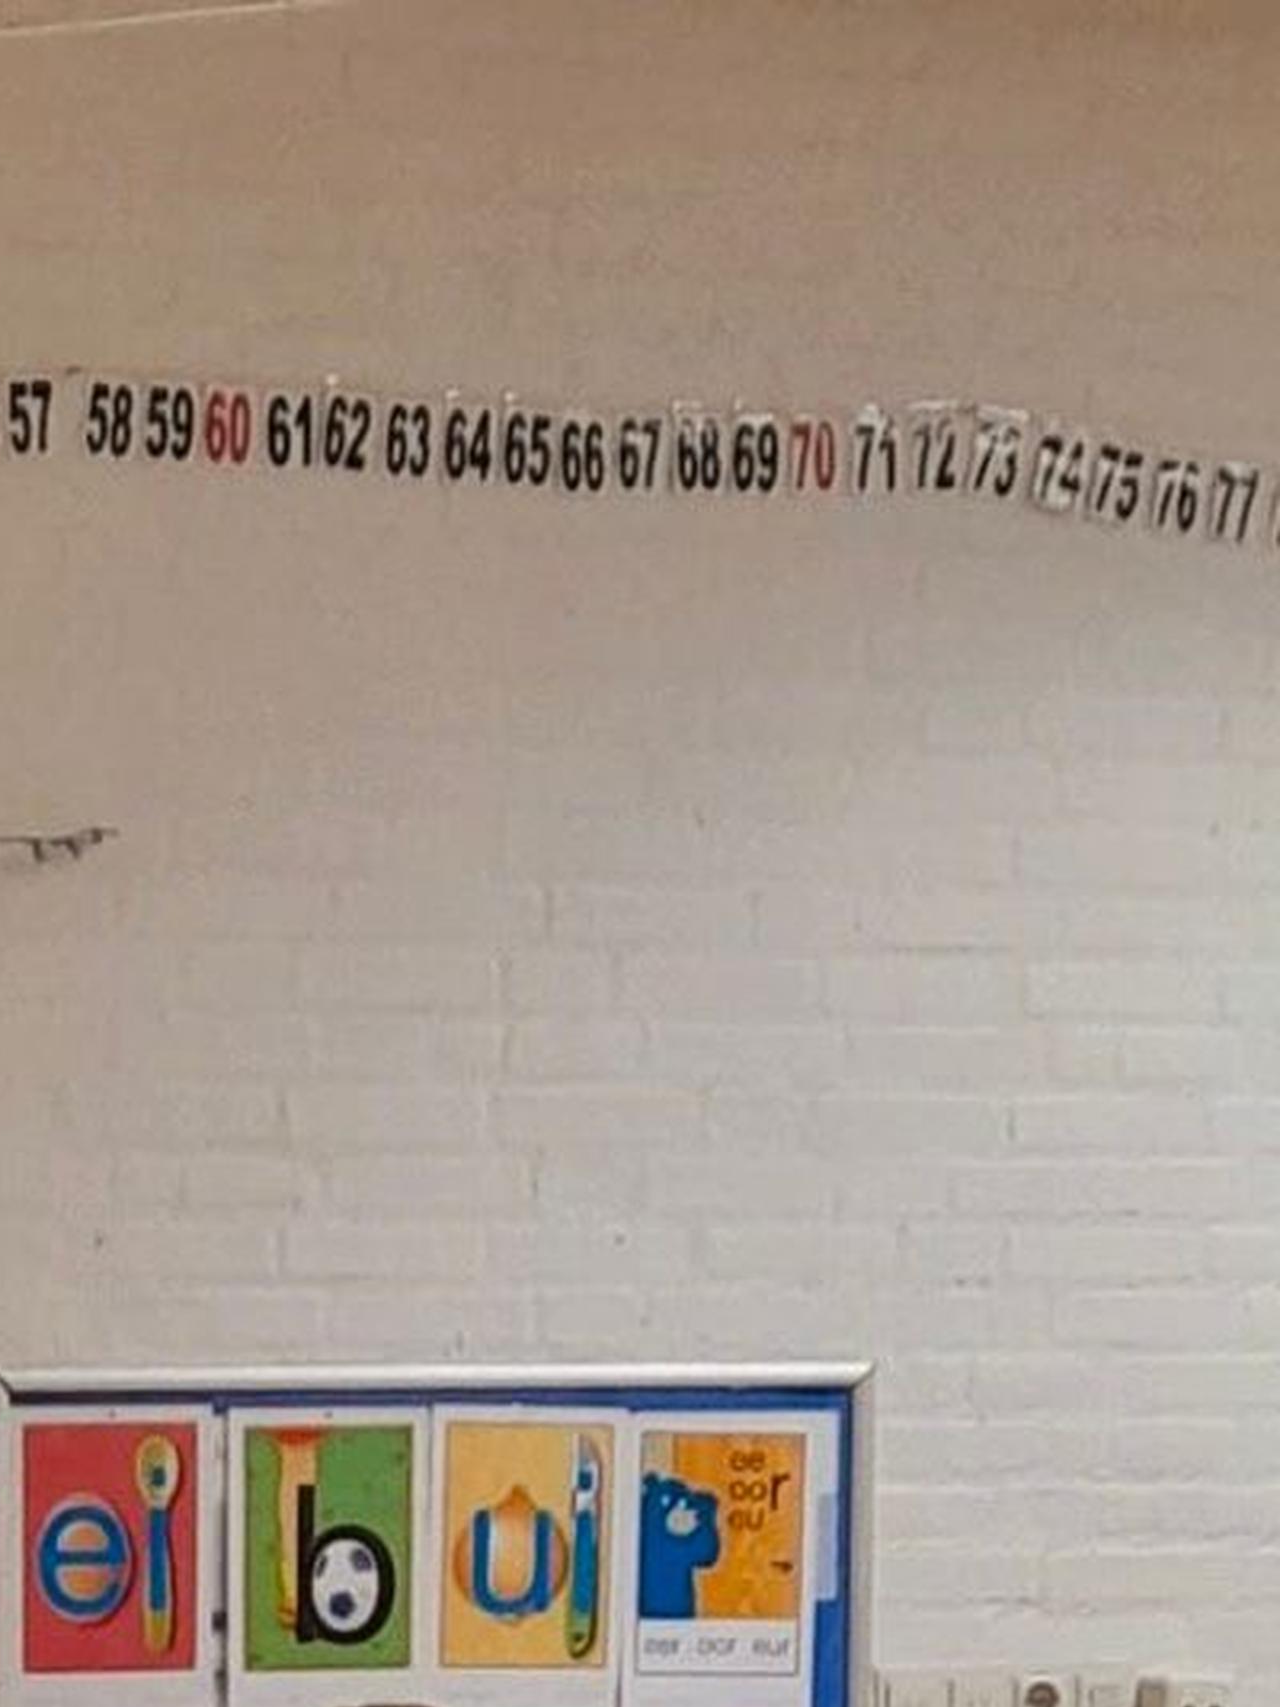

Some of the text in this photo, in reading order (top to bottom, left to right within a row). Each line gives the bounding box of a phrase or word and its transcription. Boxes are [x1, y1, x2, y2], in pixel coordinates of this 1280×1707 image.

[8, 379, 53, 455] 57
[85, 381, 134, 460] 58
[144, 385, 196, 463] 59
[202, 390, 252, 466] 60
[265, 394, 313, 469] 61
[322, 394, 372, 473] 62
[384, 403, 432, 479] 63
[442, 407, 493, 482] 64
[502, 411, 553, 488] 65
[559, 420, 606, 493] 66
[617, 417, 662, 491] 67
[667, 419, 722, 493] 68
[730, 422, 780, 495] 69
[789, 420, 837, 492] 70
[855, 420, 897, 493] 71
[912, 414, 958, 492] 72
[971, 419, 1022, 500] 73
[1038, 432, 1085, 502] 74
[1094, 440, 1146, 523] 75
[1154, 457, 1200, 535] 76
[1209, 464, 1261, 547] 77
[296, 1483, 395, 1645] b
